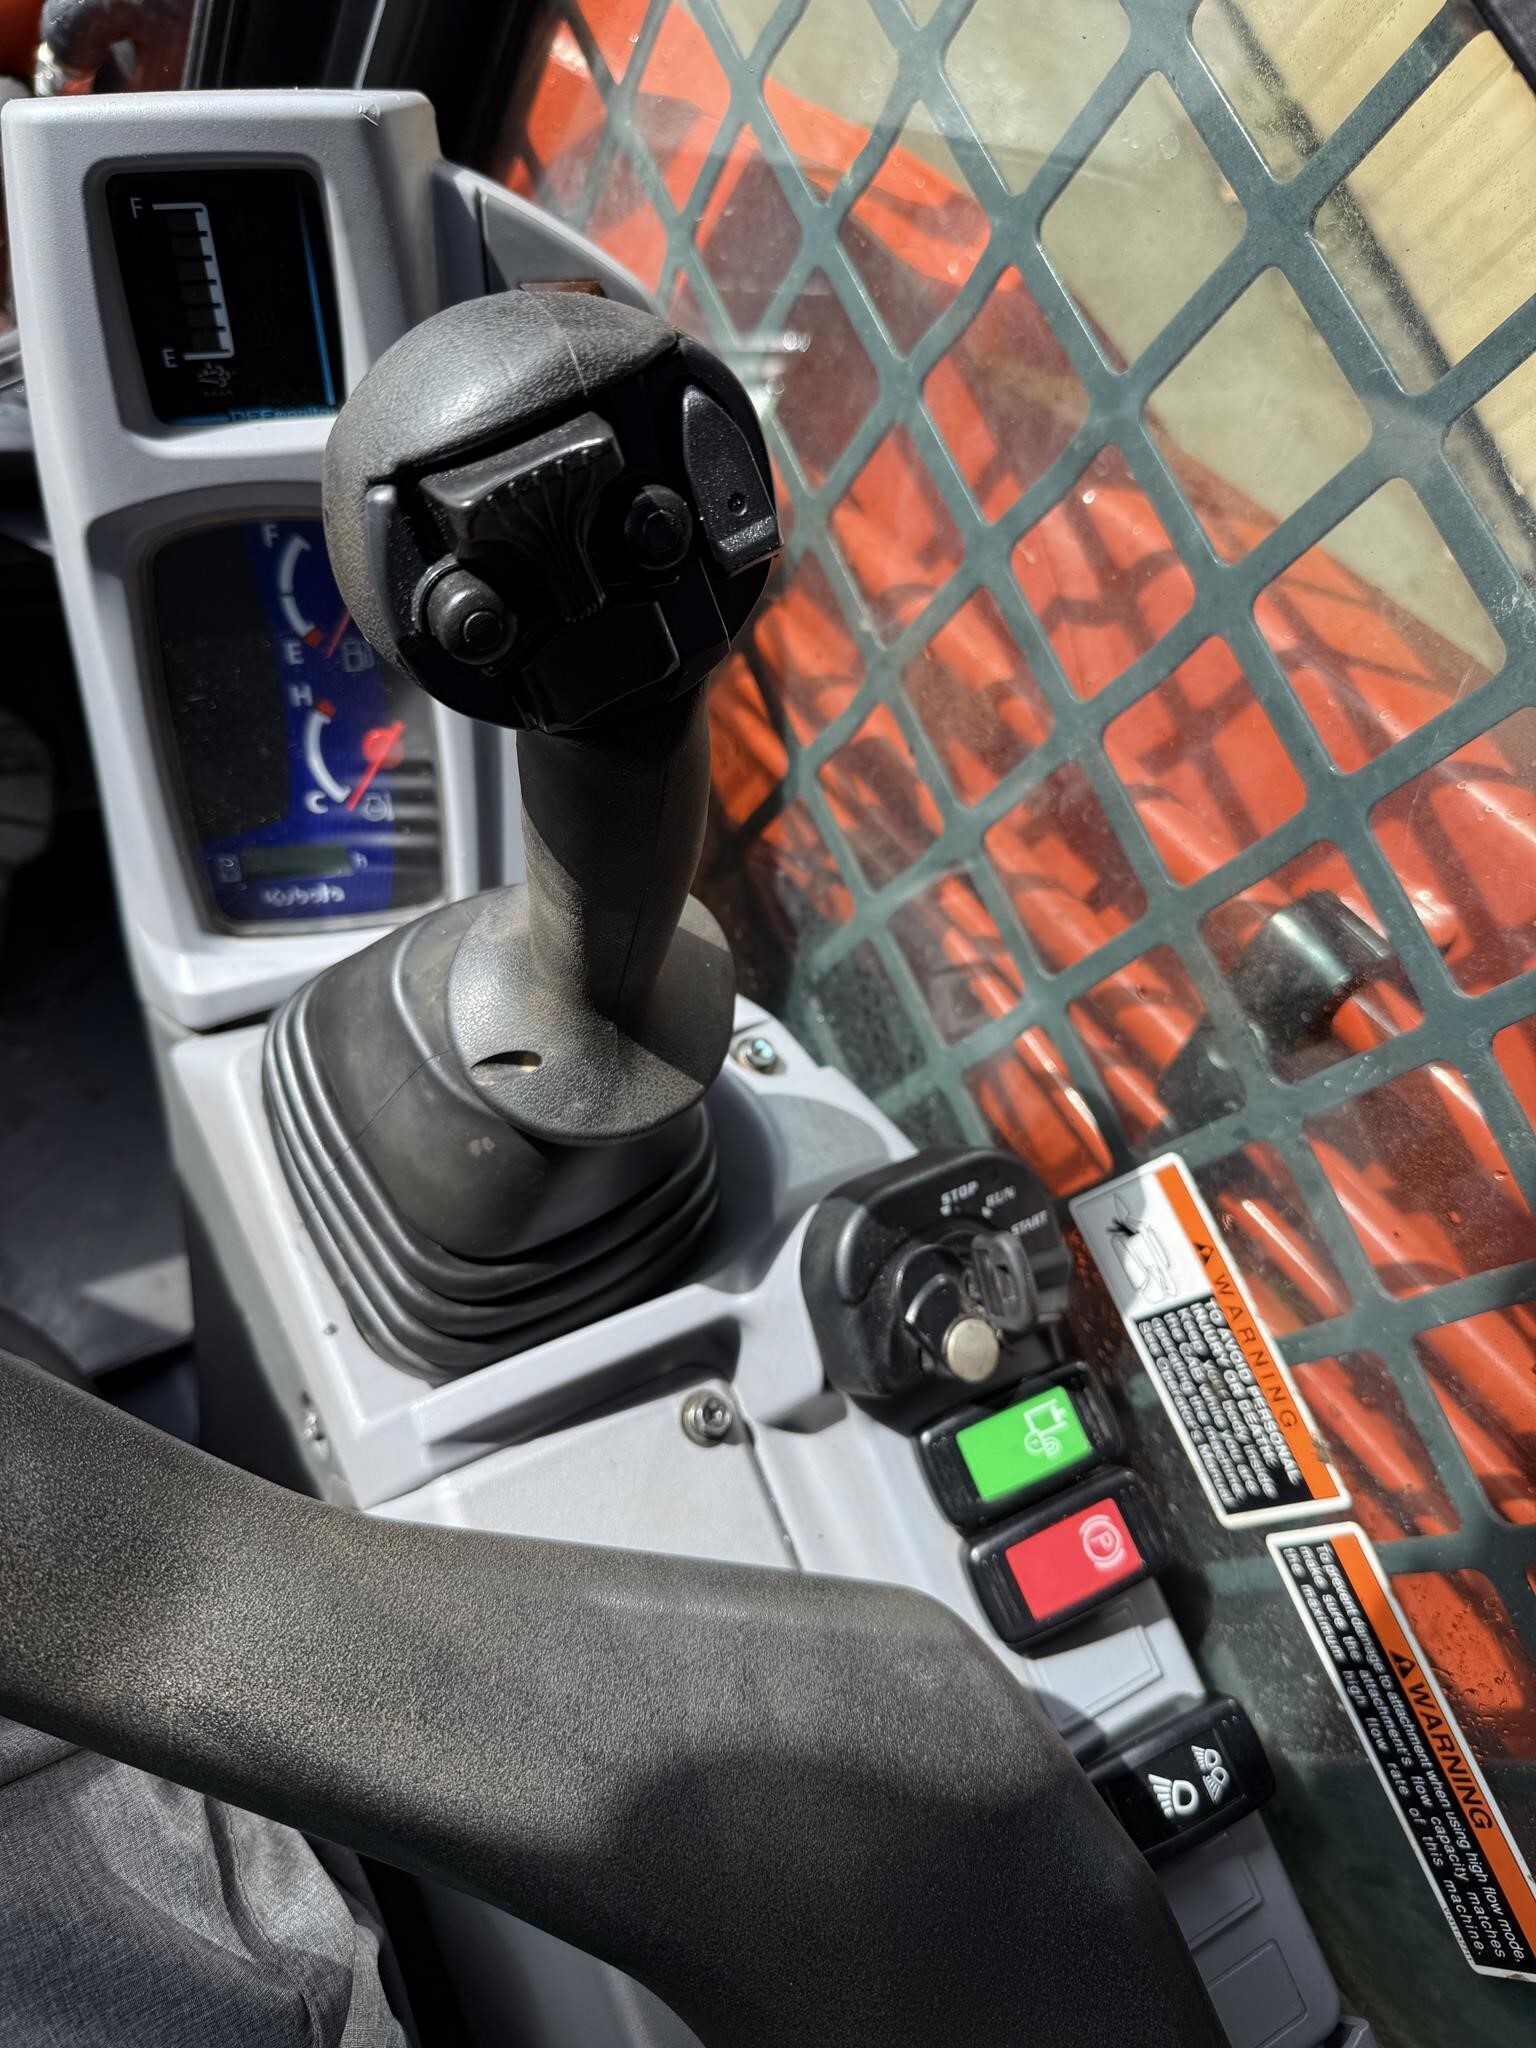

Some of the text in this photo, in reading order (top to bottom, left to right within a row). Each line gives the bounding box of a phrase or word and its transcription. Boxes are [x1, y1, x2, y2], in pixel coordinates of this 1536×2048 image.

[130, 197, 143, 218] F
[162, 349, 178, 368] E
[260, 524, 279, 549] F
[284, 643, 304, 665] E
[289, 684, 314, 707] H
[305, 790, 329, 814] C
[940, 1180, 979, 1206] STOP
[985, 1184, 1017, 1208] RUN
[1010, 1209, 1050, 1236] START
[1136, 1320, 1165, 1358] See
[1188, 1301, 1234, 1369] INJURY
[1220, 1367, 1249, 1400] OR
[1209, 1272, 1299, 1428] WARNING
[1162, 1310, 1264, 1496] the CAB while you are
[1173, 1307, 1212, 1357] Keep
[1240, 1443, 1282, 1500] inside
[1201, 1297, 1309, 1486] TO AVOID PERSONAL
[1186, 1394, 1214, 1426] the
[1281, 1546, 1308, 1578] the
[1299, 1582, 1348, 1663] maximum
[1338, 1668, 1370, 1707] high
[1363, 1715, 1393, 1753] flow
[1385, 1761, 1412, 1796] rate
[1407, 1806, 1427, 1825] of
[1420, 1835, 1447, 1866] this
[1441, 1878, 1490, 1956] machine.
[1298, 1544, 1330, 1591] make
[1320, 1592, 1349, 1631] sure
[1341, 1634, 1366, 1665] the
[1357, 1667, 1415, 1767] attachment's
[1409, 1774, 1436, 1807] flow
[1426, 1815, 1470, 1881] capacity
[1465, 1891, 1509, 1958] matches
[1314, 1542, 1528, 1962] To prevent damage to attachment when using high flow mode,
[1405, 1681, 1494, 1830] WARNING
